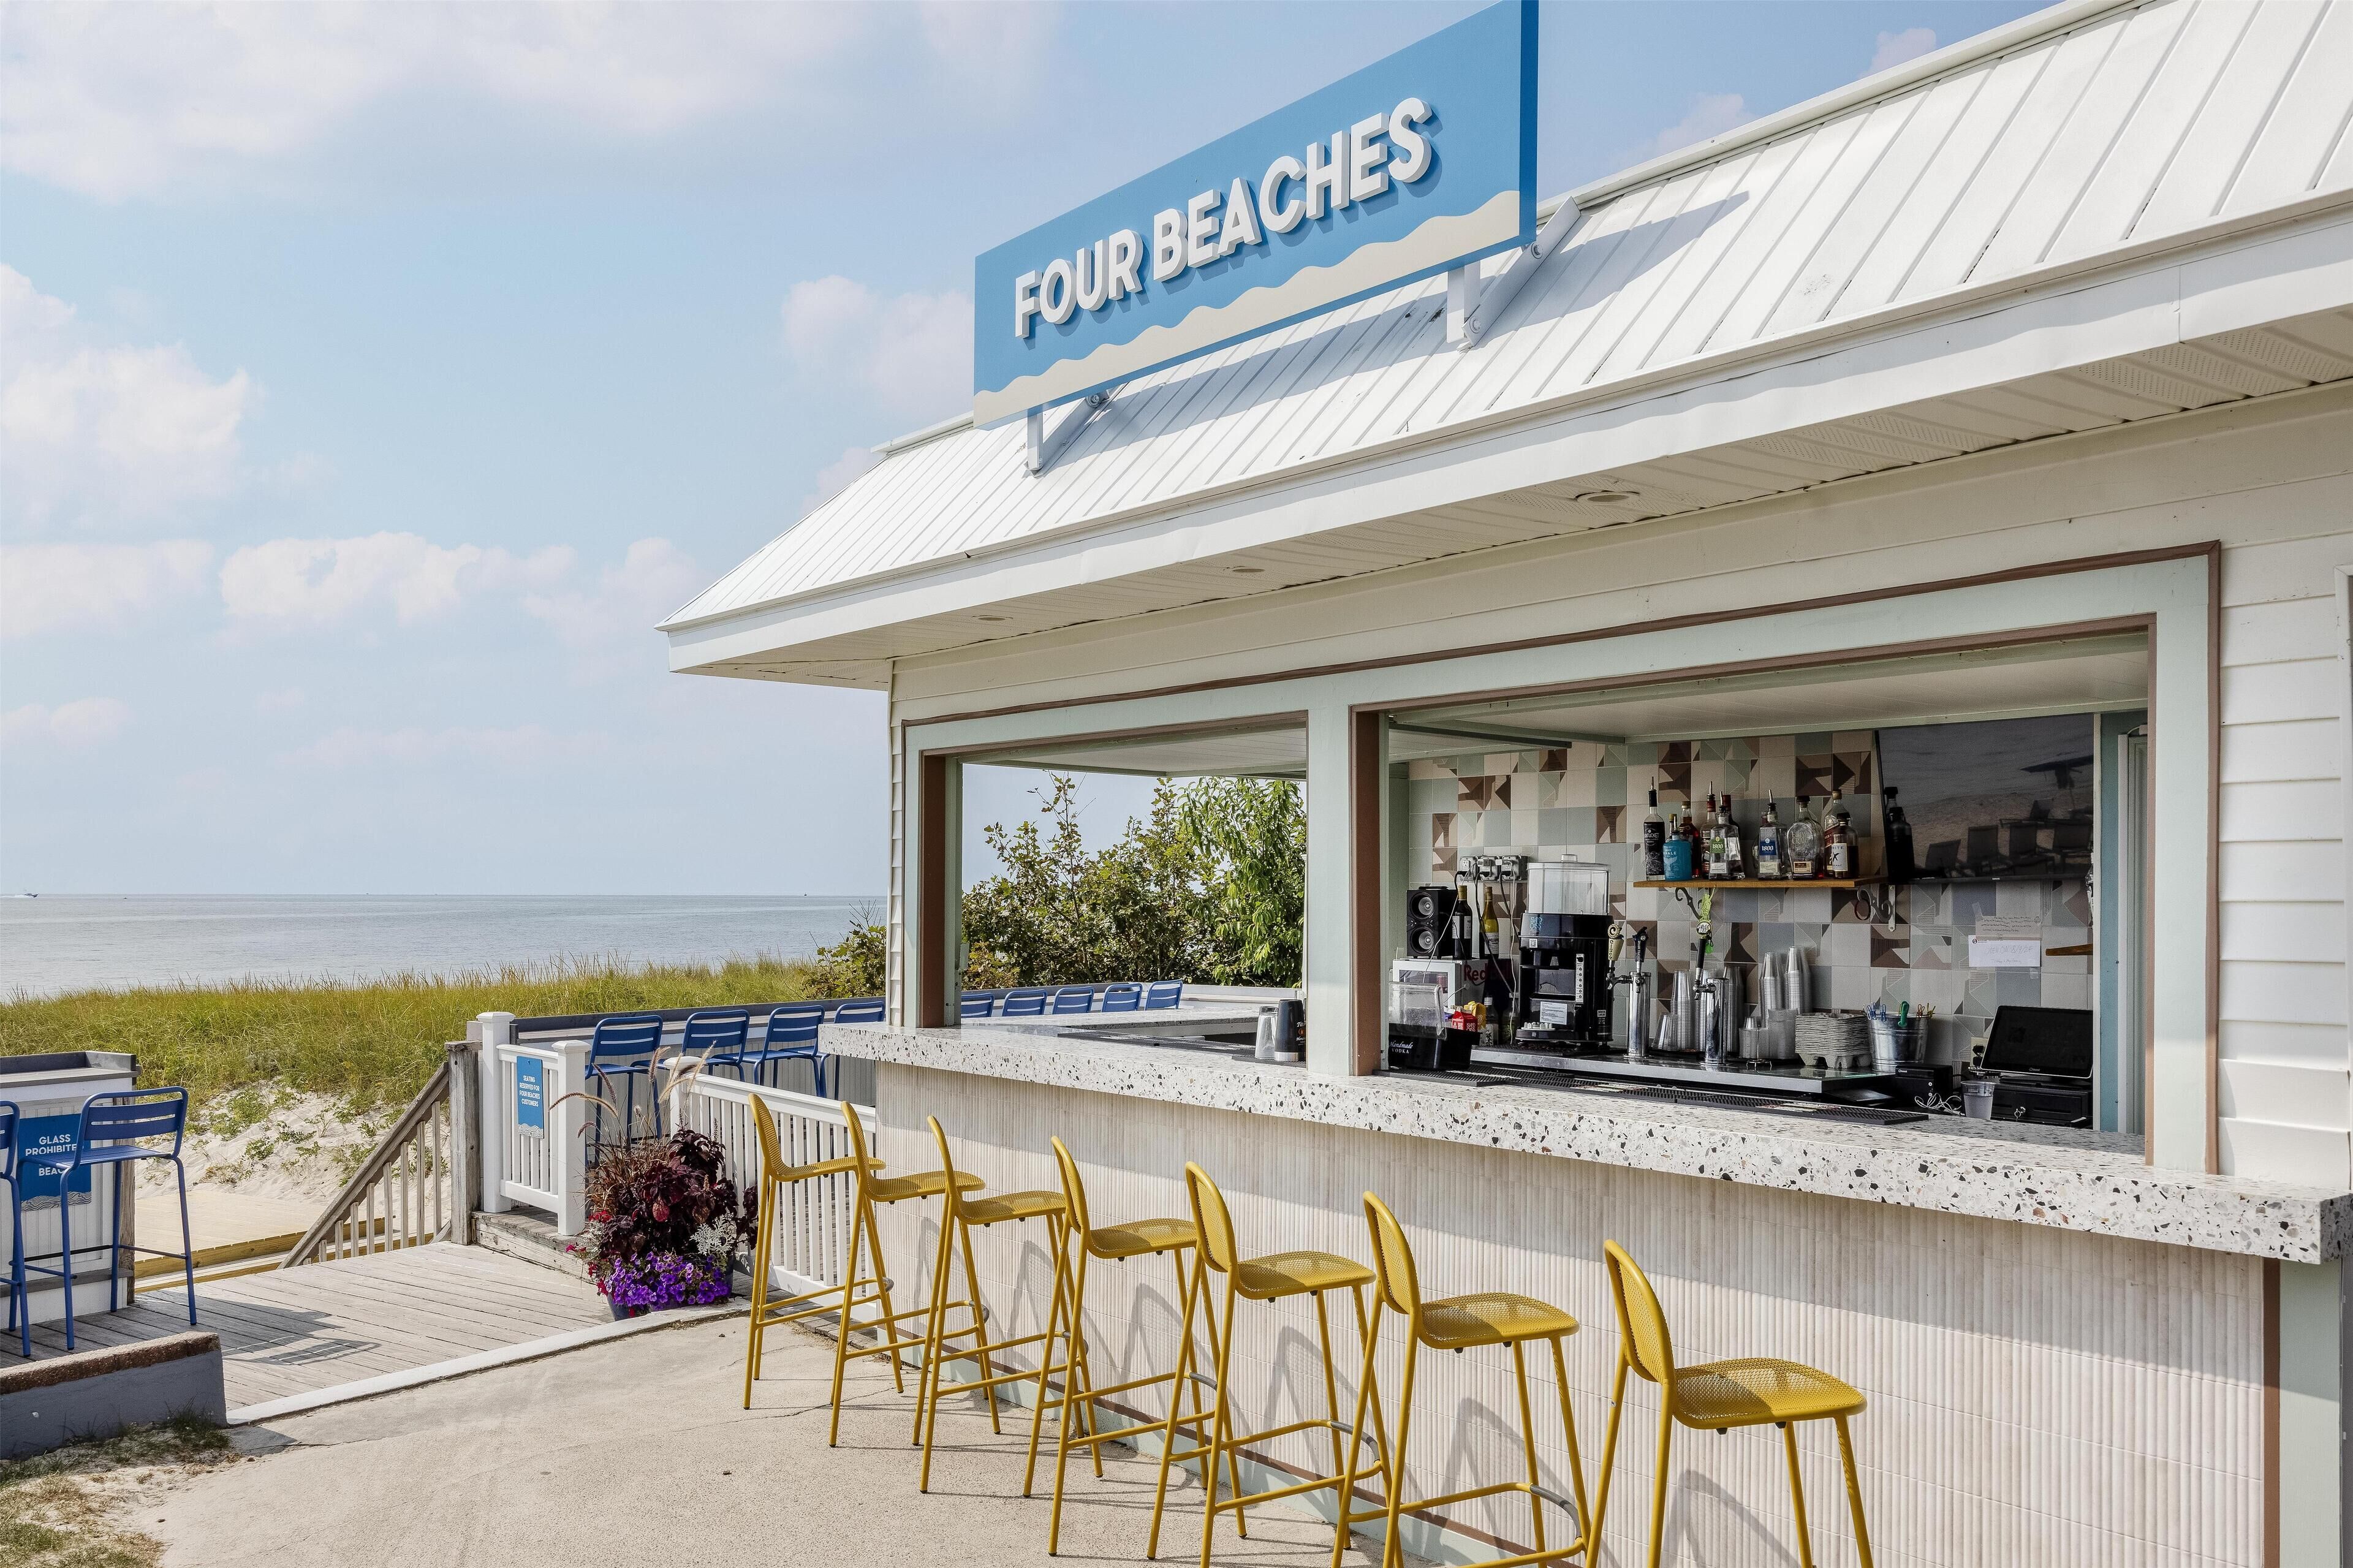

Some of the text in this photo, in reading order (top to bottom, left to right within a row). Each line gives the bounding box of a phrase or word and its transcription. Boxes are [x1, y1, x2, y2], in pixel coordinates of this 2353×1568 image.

[1015, 97, 1433, 339] FOUR BEACHES
[1464, 962, 1488, 982] Red
[39, 1134, 71, 1145] GLASS
[25, 1143, 77, 1156] PROHIBITE
